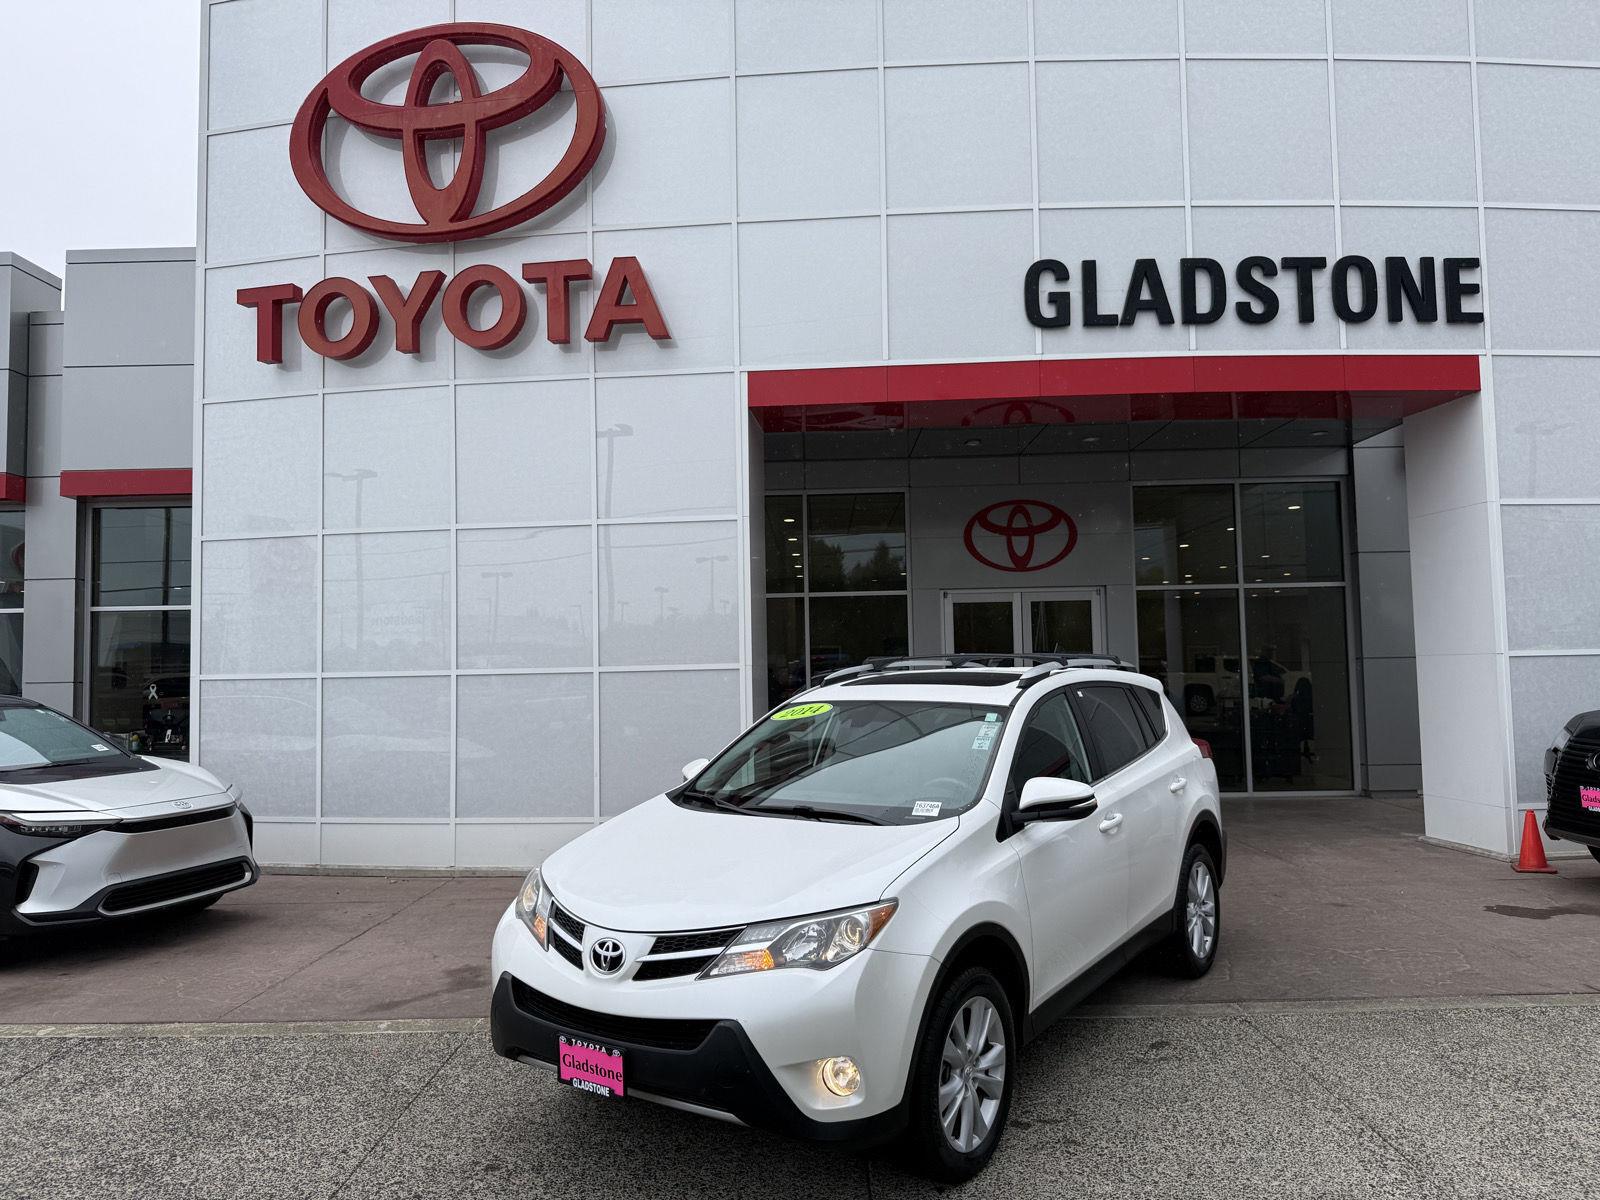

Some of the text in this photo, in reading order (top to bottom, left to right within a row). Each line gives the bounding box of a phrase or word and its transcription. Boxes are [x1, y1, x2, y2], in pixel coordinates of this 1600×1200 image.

[1024, 255, 1484, 328] GLADSTONE
[236, 256, 672, 364] TOYOTA
[779, 704, 825, 719] 2014
[571, 1038, 606, 1053] TOYOTA
[562, 1053, 623, 1082] Gladstone
[572, 1077, 610, 1097] GLADSTONE
